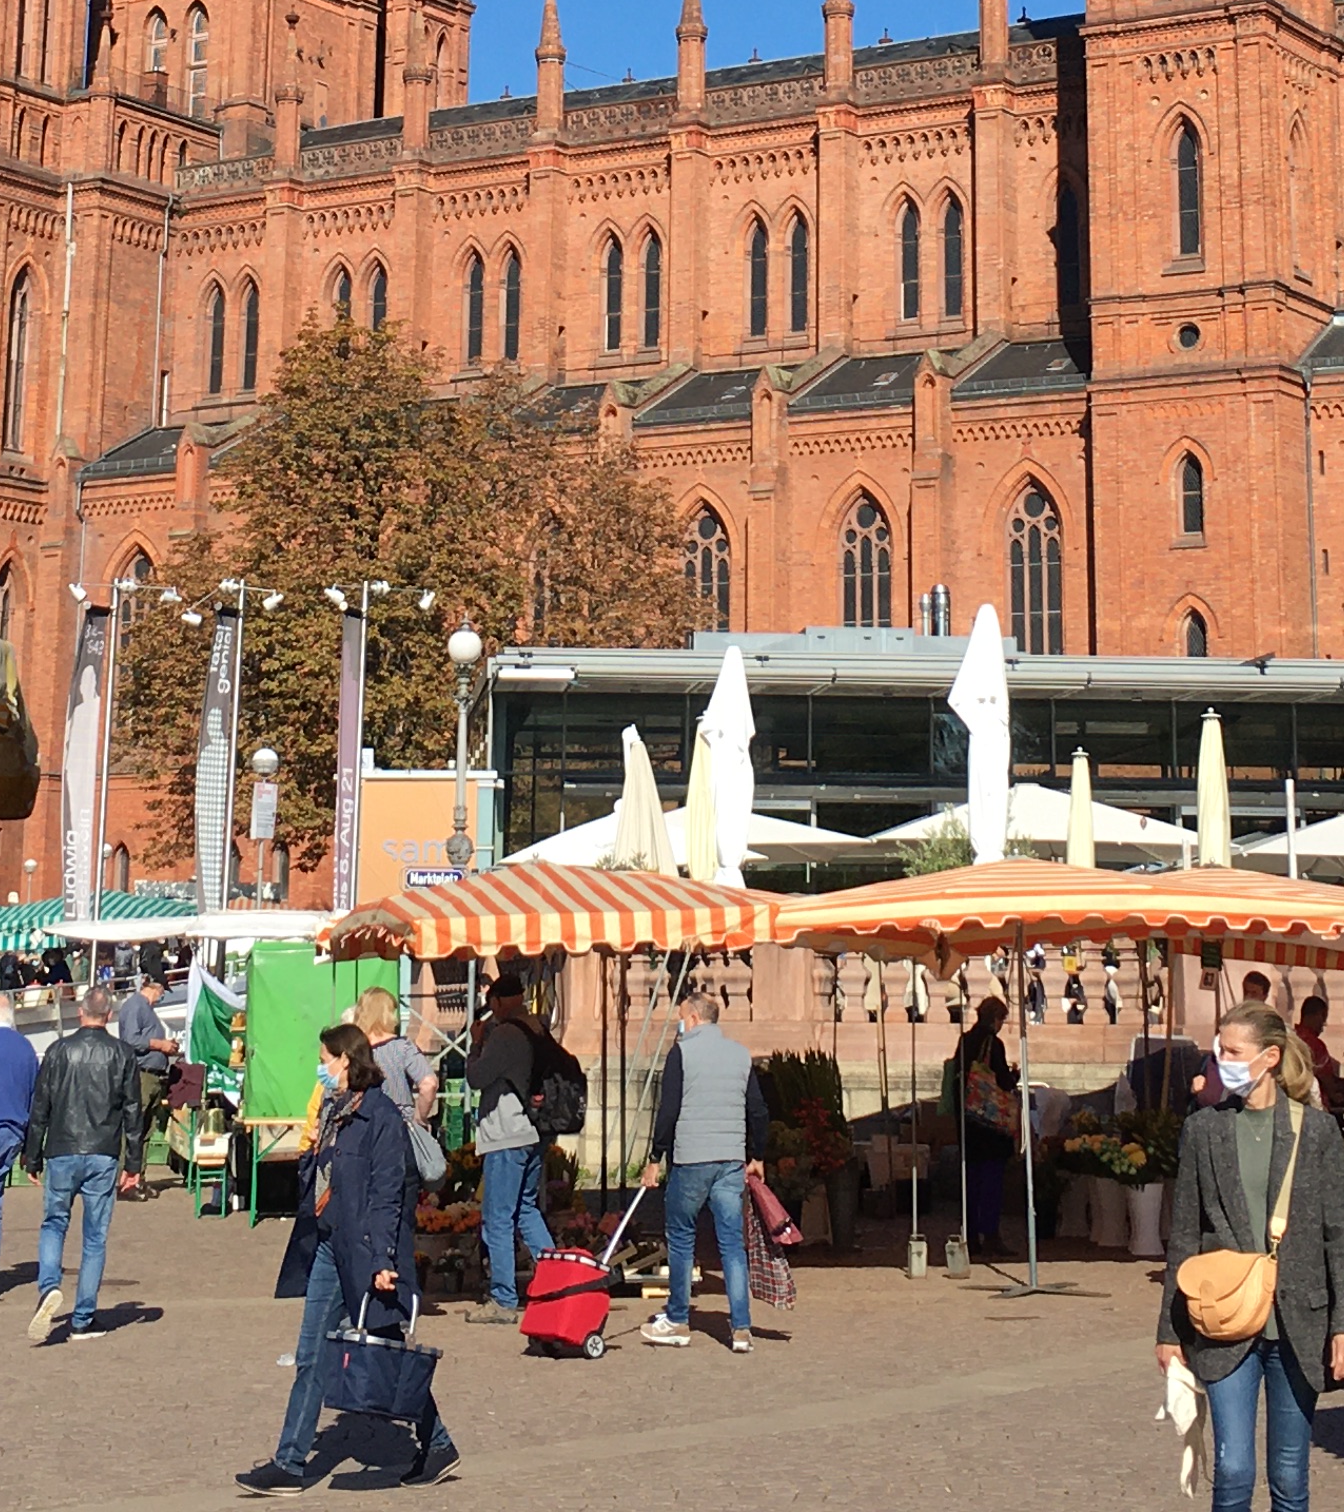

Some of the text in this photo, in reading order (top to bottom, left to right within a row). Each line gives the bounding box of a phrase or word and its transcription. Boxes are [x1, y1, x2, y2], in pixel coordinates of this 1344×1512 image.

[216, 626, 233, 694] genial
[341, 767, 354, 793] 21
[339, 799, 355, 848] Aug
[64, 829, 79, 918] Ludwig
[409, 871, 459, 886] Marktplatz
